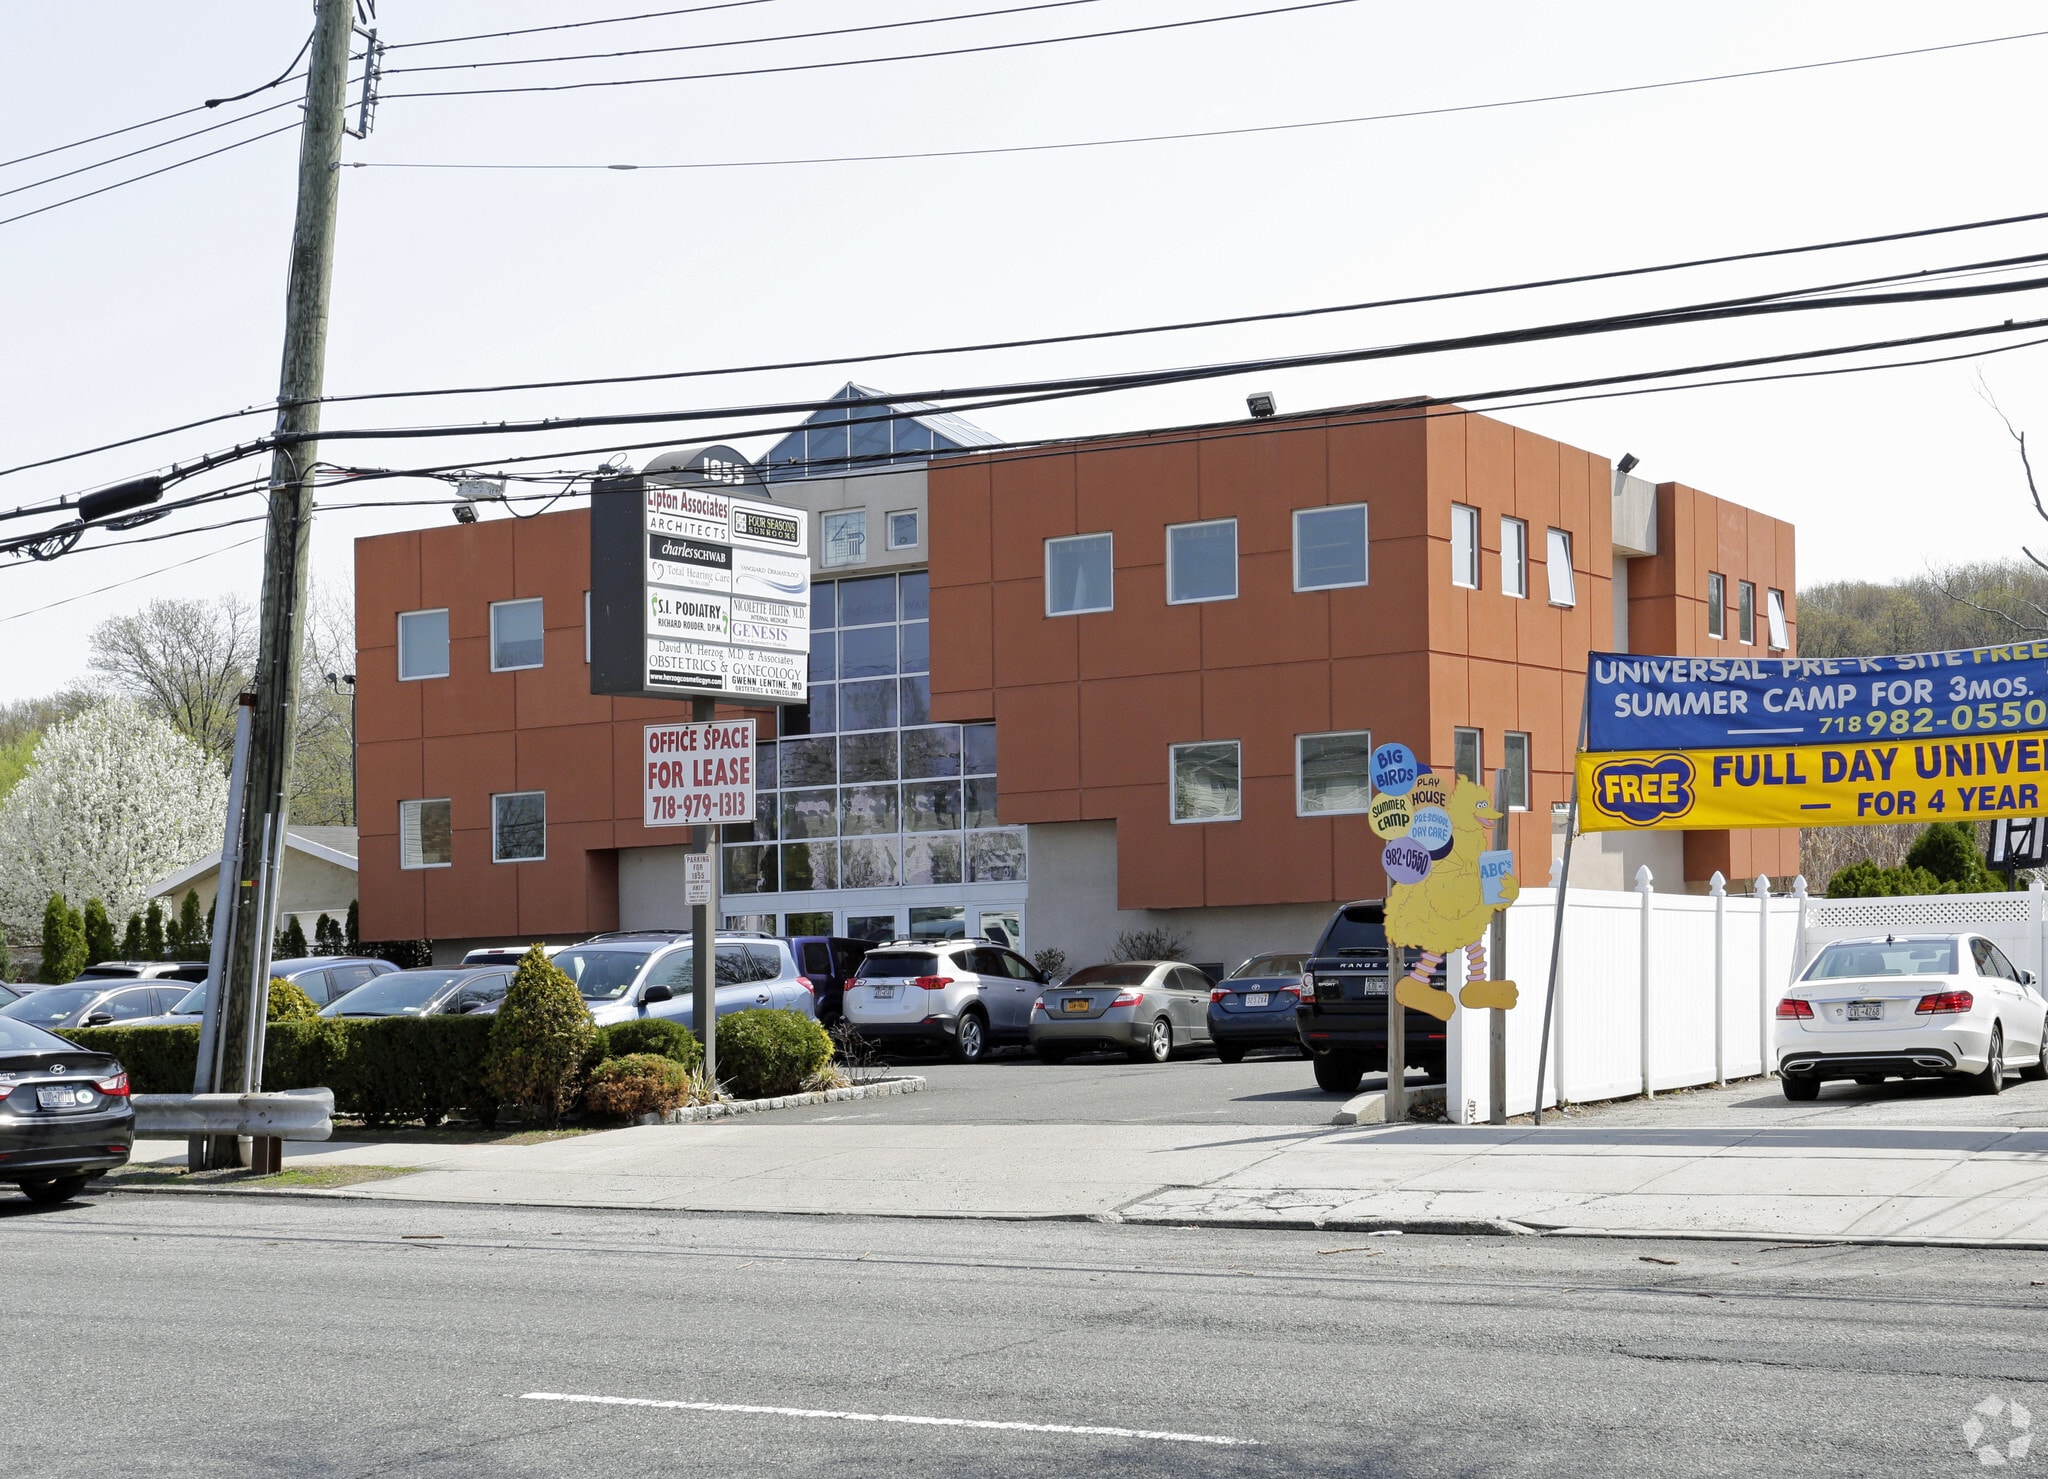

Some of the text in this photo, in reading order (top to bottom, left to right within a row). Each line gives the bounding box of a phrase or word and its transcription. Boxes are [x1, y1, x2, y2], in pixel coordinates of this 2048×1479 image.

[703, 457, 744, 484] 1855
[648, 485, 727, 518] Lipton Associates
[651, 518, 726, 539] ARCHITECTS
[748, 515, 796, 533] FOUR SEASONS
[748, 526, 796, 540] SUNROOMS
[667, 565, 730, 582] Total Hearing Care
[658, 599, 721, 619] S.I. PODIATRY
[733, 600, 767, 614] NICOLETTE
[793, 607, 806, 619] M.D.
[658, 618, 681, 628] RICHARD
[733, 622, 788, 641] GENESIS
[659, 640, 681, 653] David
[685, 643, 694, 654] M.
[728, 648, 745, 660] M.D.
[748, 650, 754, 660] &
[758, 651, 794, 665] Associates
[649, 655, 801, 680] OBSTETRICS & GYNECOLOGY
[1595, 643, 2048, 684] UNIVERSAL PRE-K SITE FREE
[732, 676, 756, 686] GWENN
[792, 682, 802, 691] MD
[735, 685, 763, 693] OBSTETRICS
[770, 688, 799, 697] GYNECOLOGY
[1614, 675, 2034, 718] SUMMER CAMP FOR 3MOS.
[1819, 699, 2047, 735] 718 982-0550
[649, 726, 749, 753] OFFICE SPACE
[1377, 749, 1403, 769] BIG
[1713, 739, 2048, 787] FULL DAY UNIVE
[648, 757, 750, 789] FOR LEASE
[1376, 768, 1413, 788] BIRDS
[1417, 778, 1440, 787] PLAY
[1603, 772, 1679, 804] FREE
[653, 791, 746, 819] 718-979-1313
[1372, 798, 1406, 818] SUMMER
[1412, 790, 1446, 807] HOUSE
[1857, 783, 2039, 817] FOR 4 YEAR
[1378, 813, 1410, 831] CAMP
[1413, 813, 1449, 828] PRE-SCHOOL
[1412, 826, 1448, 841] DAY CARE
[687, 855, 709, 863] PARKING
[693, 863, 703, 871] FOR
[1480, 860, 1511, 878] ABC's
[692, 871, 704, 880] 1855
